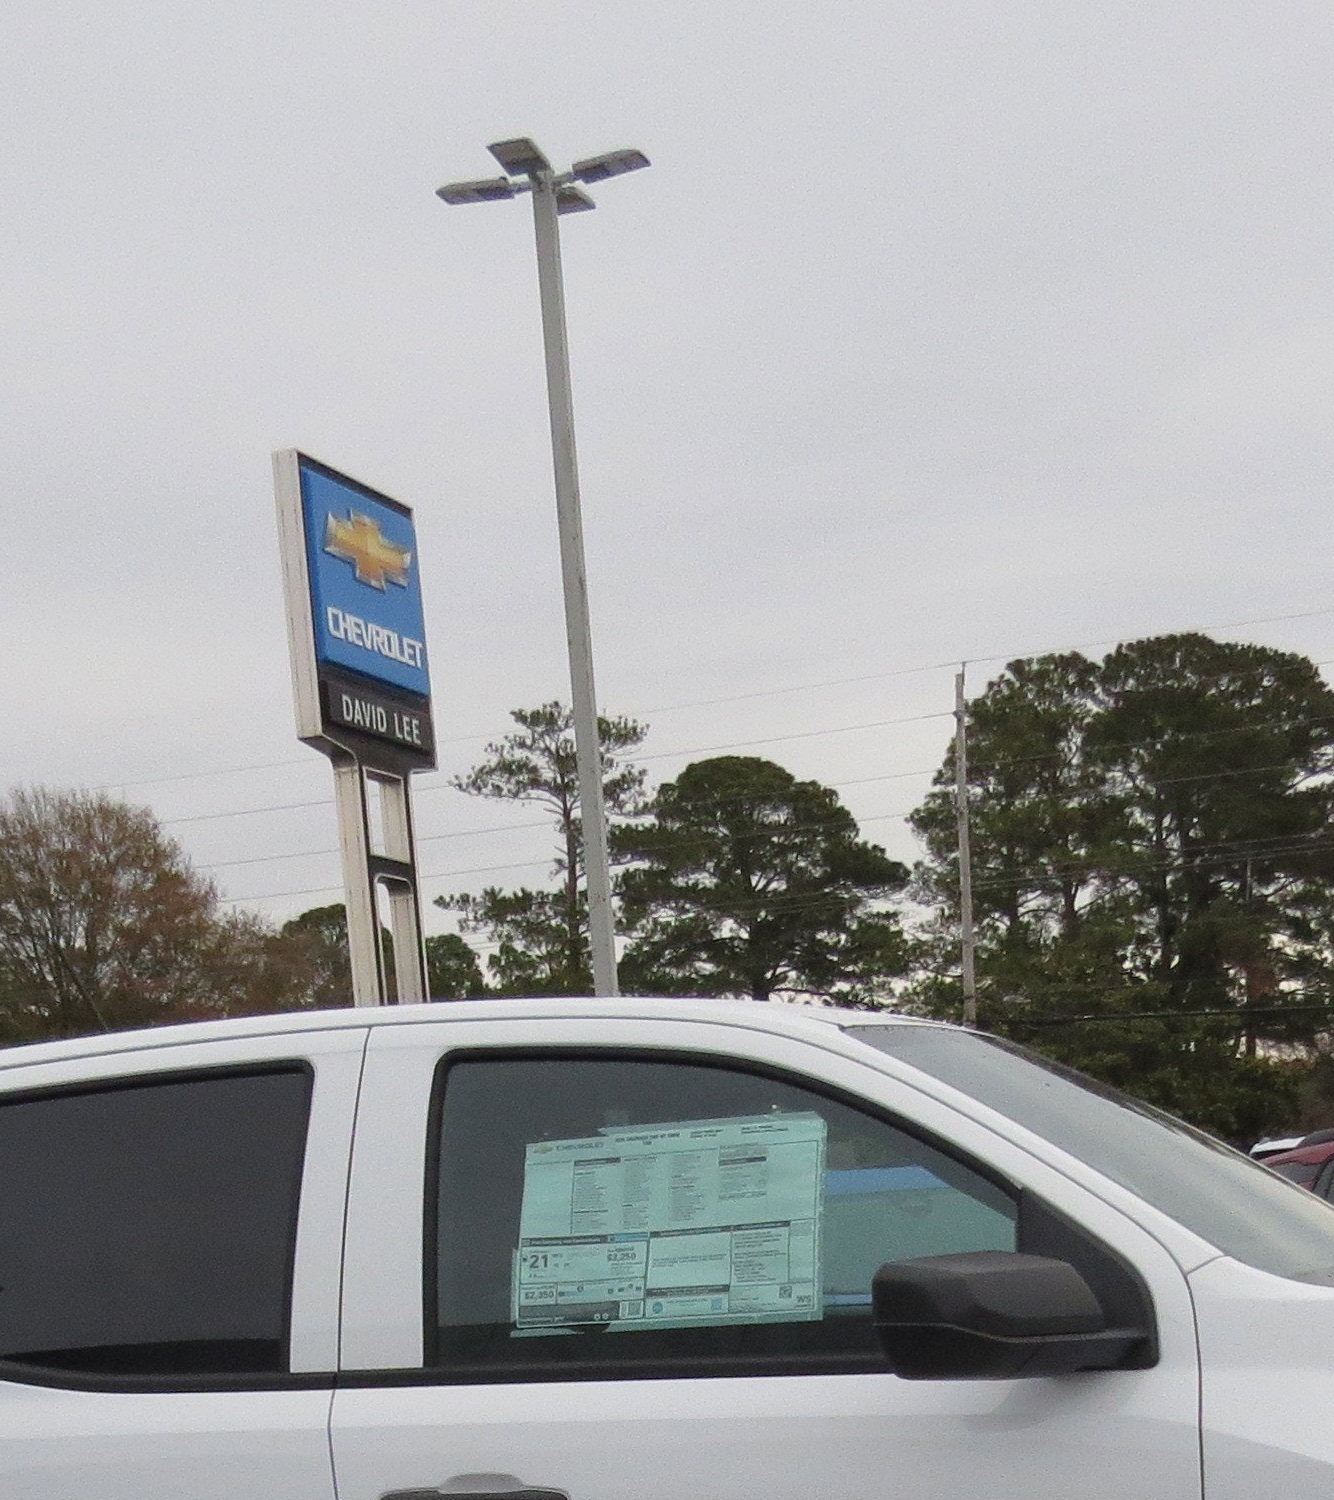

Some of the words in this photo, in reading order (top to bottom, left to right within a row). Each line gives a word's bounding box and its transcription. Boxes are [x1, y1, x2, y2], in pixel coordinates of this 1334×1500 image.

[326, 606, 422, 670] CHEVROLET
[341, 693, 387, 733] DAVID
[394, 712, 422, 745] LEE
[529, 1254, 549, 1269] 21
